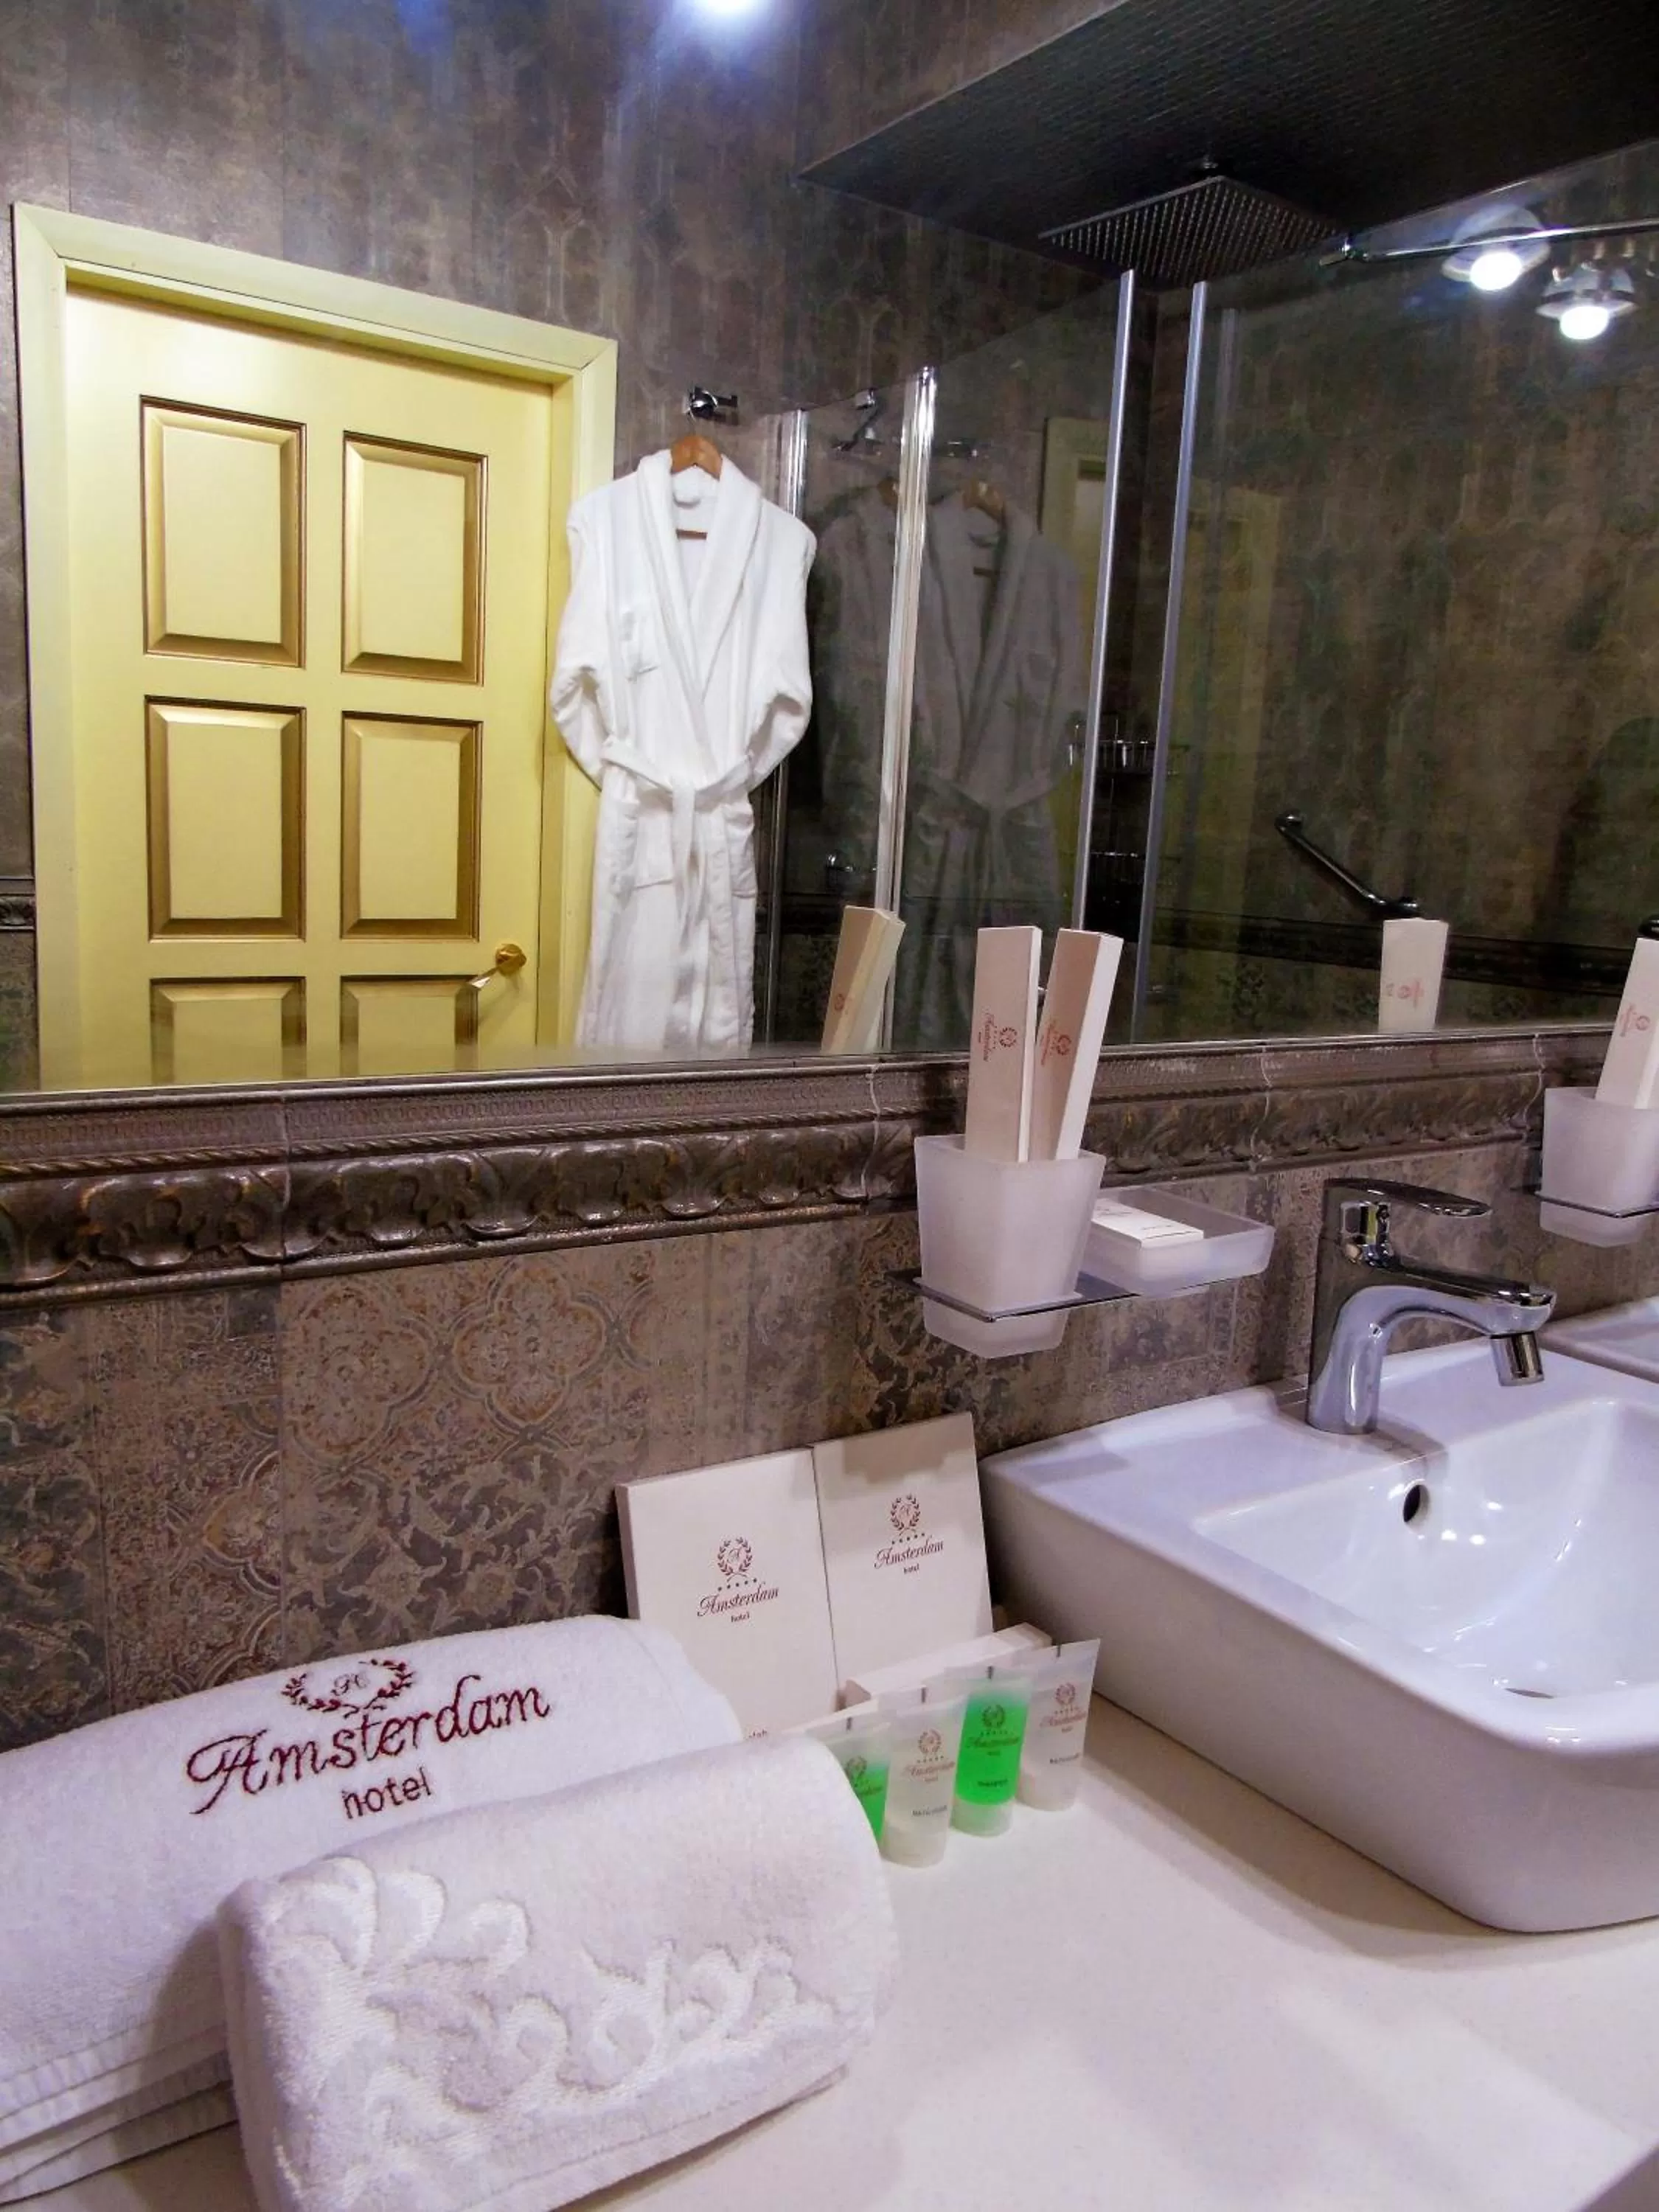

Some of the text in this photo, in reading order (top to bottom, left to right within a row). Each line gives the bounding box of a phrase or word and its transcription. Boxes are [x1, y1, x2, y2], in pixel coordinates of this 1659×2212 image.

[874, 1535, 944, 1569] Amsterdam
[697, 1582, 779, 1617] Amsterdam
[186, 1674, 550, 1815] Amsterdam
[341, 1766, 431, 1820] hotel
